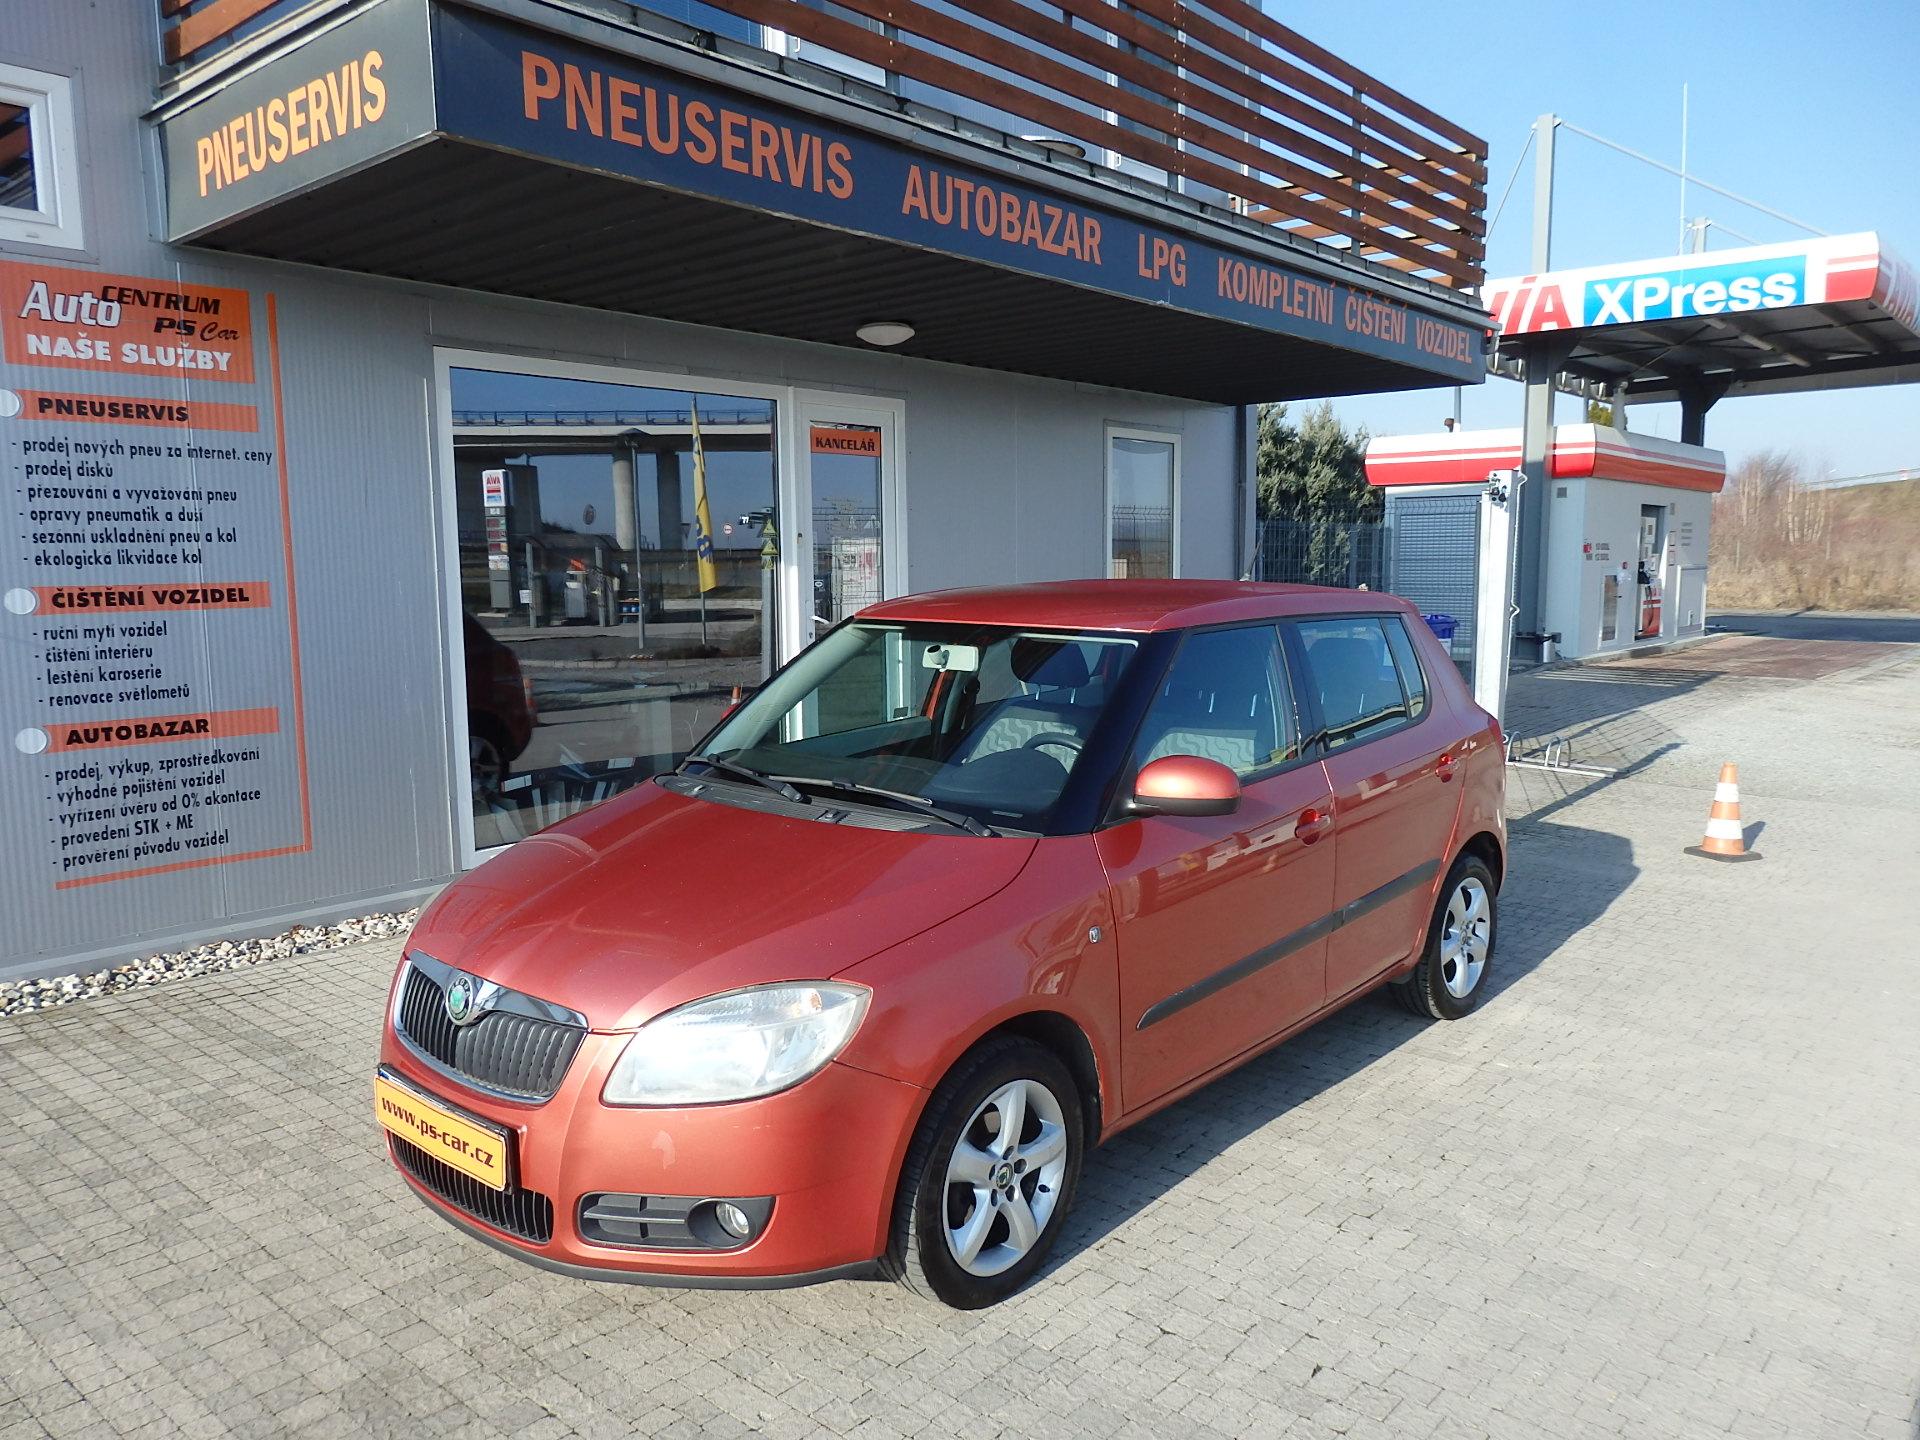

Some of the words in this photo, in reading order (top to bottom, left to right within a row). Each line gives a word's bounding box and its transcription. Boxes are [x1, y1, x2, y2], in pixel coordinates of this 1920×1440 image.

[197, 50, 387, 197] PNEUSERVIS
[521, 50, 853, 199] PNEUSERVIS
[901, 164, 1102, 265] AUTOBAZAR
[1138, 233, 1187, 287] LPG
[1217, 257, 1336, 325] KOMPLETNÍ
[1345, 286, 1408, 345] ČIŠTĚNÍ
[1416, 317, 1472, 364] VOZIDEL
[18, 280, 122, 328] Auto
[101, 285, 220, 315] CENTRUM
[1590, 271, 1797, 327] XPress
[154, 317, 197, 336] PS
[200, 322, 240, 341] Car
[26, 332, 112, 362] NAŠE
[121, 341, 231, 372] SLUŽBY
[38, 397, 189, 422] PNEUSERVIS
[23, 437, 69, 457] prodej
[74, 439, 124, 458] nových
[129, 444, 162, 459] pneu
[166, 446, 182, 458] za
[187, 443, 240, 461] internet.
[245, 450, 272, 466] ceny
[816, 437, 875, 451] KANCELÁŘ
[25, 460, 72, 480] prodej
[77, 461, 113, 478] disků
[28, 484, 107, 502] přezouvání
[113, 489, 121, 499] a
[126, 487, 202, 504] vyvažování
[207, 491, 237, 505] pneu
[30, 510, 80, 525] opravy
[87, 506, 160, 525] pneumatik
[165, 511, 173, 522] a
[32, 529, 86, 544] sezónní
[91, 527, 165, 543] uskladnění
[169, 532, 200, 546] pneu
[205, 532, 213, 543] a
[217, 527, 237, 543] kol
[35, 550, 112, 569] ekologická
[117, 549, 178, 565] likvidace
[182, 548, 202, 564] kol
[52, 586, 145, 608] ČIŠTĚNÍ
[153, 587, 250, 605] VOZIDEL
[43, 625, 79, 640] ruční
[120, 620, 168, 637] vozidel
[46, 646, 91, 663] čištění
[95, 643, 153, 660] interiéru
[47, 668, 94, 685] leštění
[98, 664, 162, 682] karoserie
[49, 692, 113, 707] renovace
[118, 684, 190, 702] světlometů
[66, 718, 210, 745] AUTOBAZAR
[55, 762, 103, 785] prodej,
[108, 758, 154, 779] výkup,
[158, 747, 260, 773] zprostředkování
[57, 783, 117, 806] výhodné
[122, 775, 176, 799] pojištění
[181, 769, 225, 788] vozidel
[59, 803, 116, 828] vyřízení
[120, 801, 157, 817] úvěru
[162, 795, 177, 811] od
[182, 792, 201, 809] 0%
[205, 789, 261, 806] akontace
[61, 823, 130, 850] provedení
[135, 818, 159, 836] STK
[165, 821, 171, 830] +
[176, 814, 194, 830] ME
[63, 845, 129, 872] prověření
[134, 837, 180, 860] původu
[185, 829, 229, 849] vozidel
[382, 1097, 494, 1169] www.ps-car.cz
